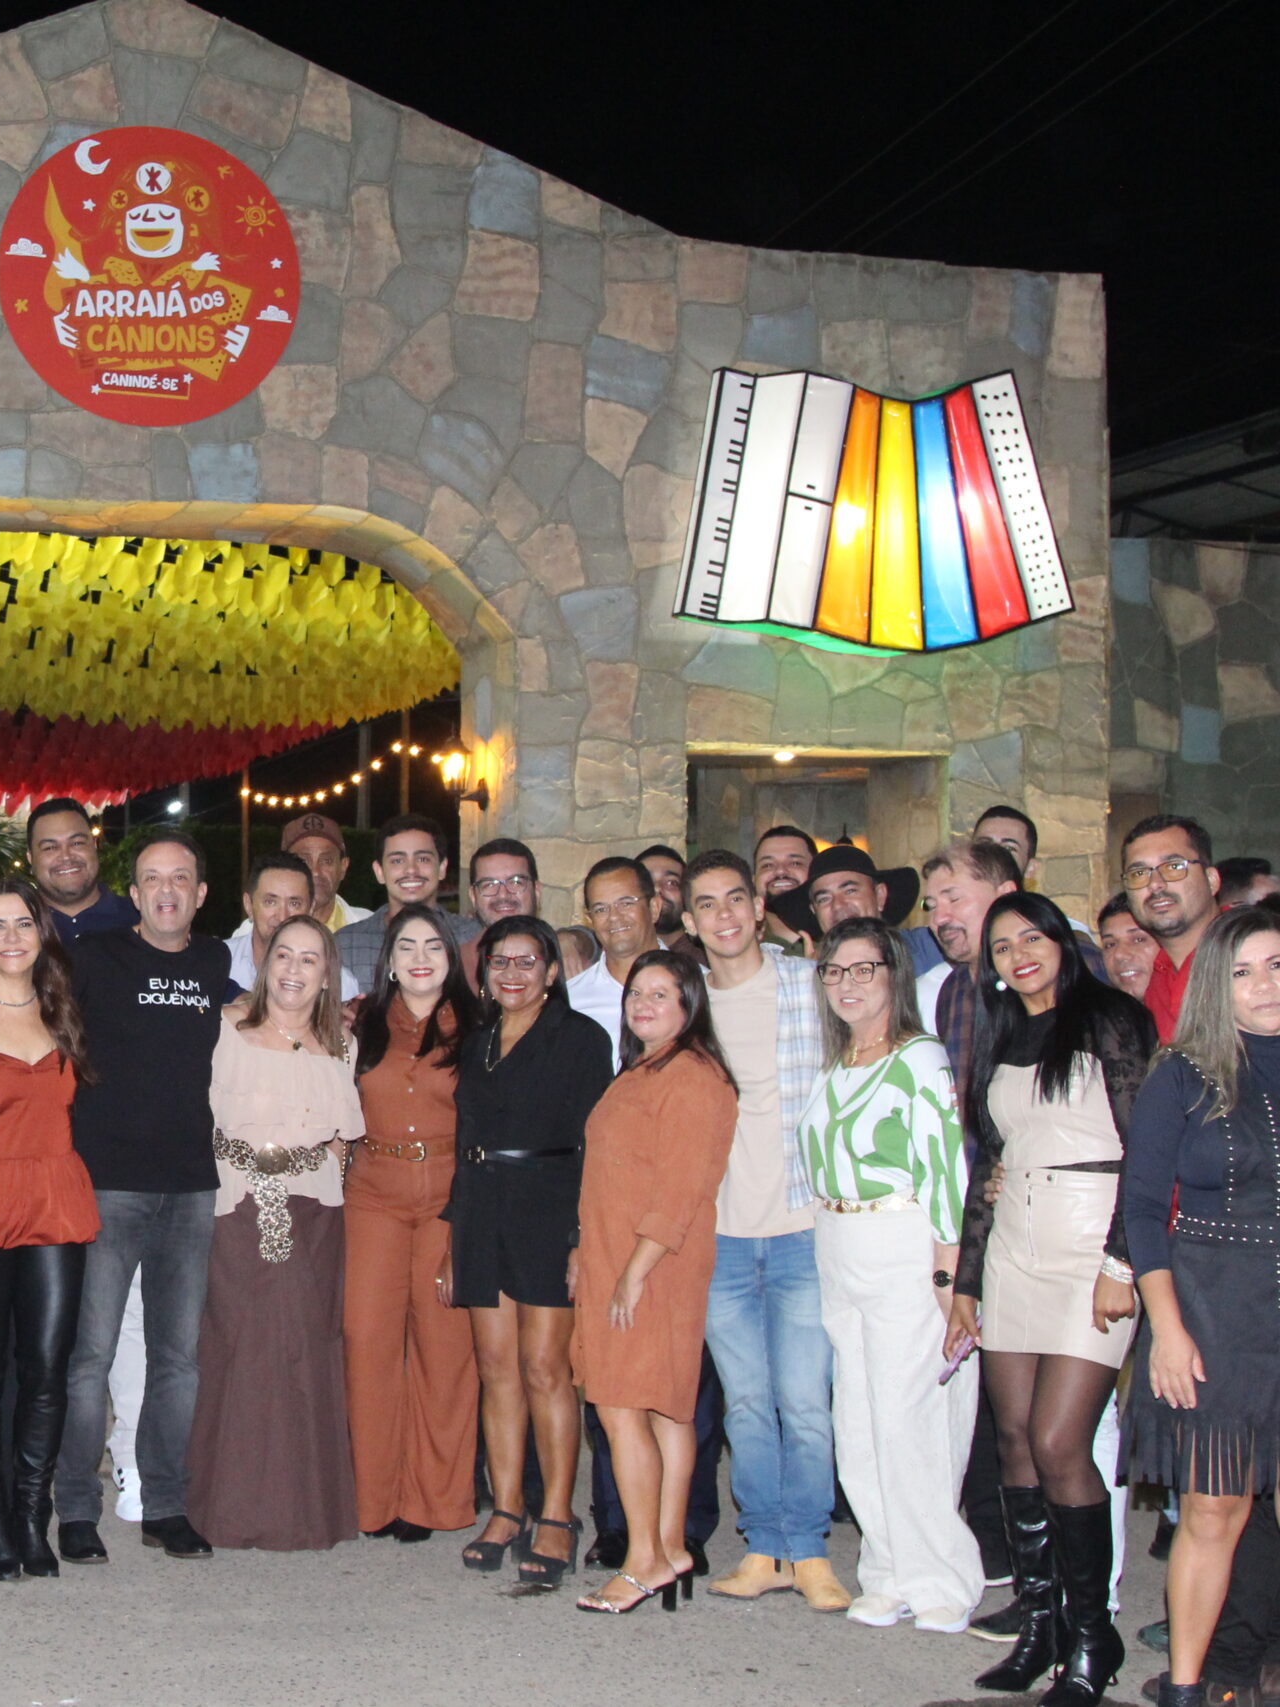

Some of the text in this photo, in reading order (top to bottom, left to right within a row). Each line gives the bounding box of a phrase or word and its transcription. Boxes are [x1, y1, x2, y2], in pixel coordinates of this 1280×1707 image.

[75, 281, 225, 318] ARRAIÁ DOS
[86, 318, 216, 353] CÂNIONS
[101, 372, 179, 391] CANINDÉ-SE
[149, 978, 200, 992] EU NUM
